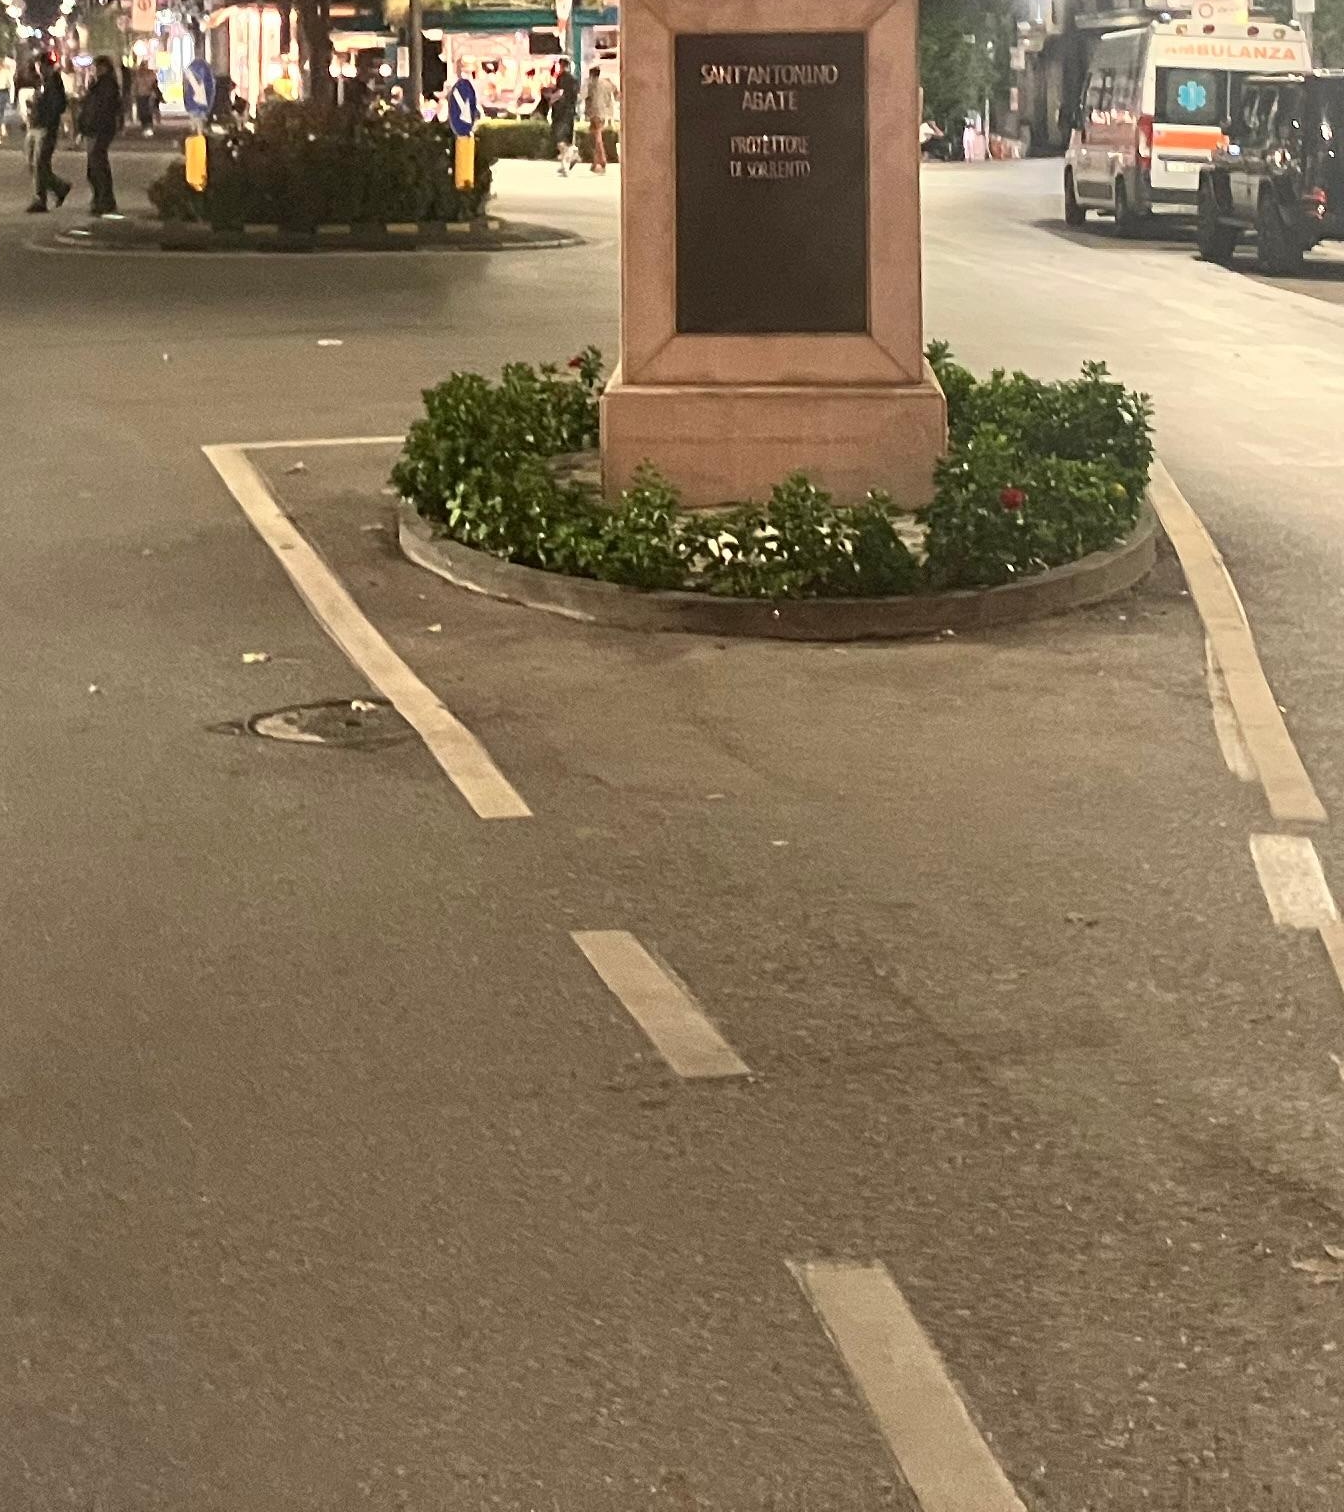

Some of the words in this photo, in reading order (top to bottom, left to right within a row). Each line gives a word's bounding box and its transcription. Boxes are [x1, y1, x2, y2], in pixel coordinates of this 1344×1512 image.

[1165, 43, 1297, 61] AMBULANZA
[700, 64, 839, 85] SANT'ANTONINO
[742, 90, 798, 111] ABATE
[730, 135, 811, 155] PROTETTORE
[730, 160, 742, 178] DI
[747, 160, 812, 179] SORRENTO
